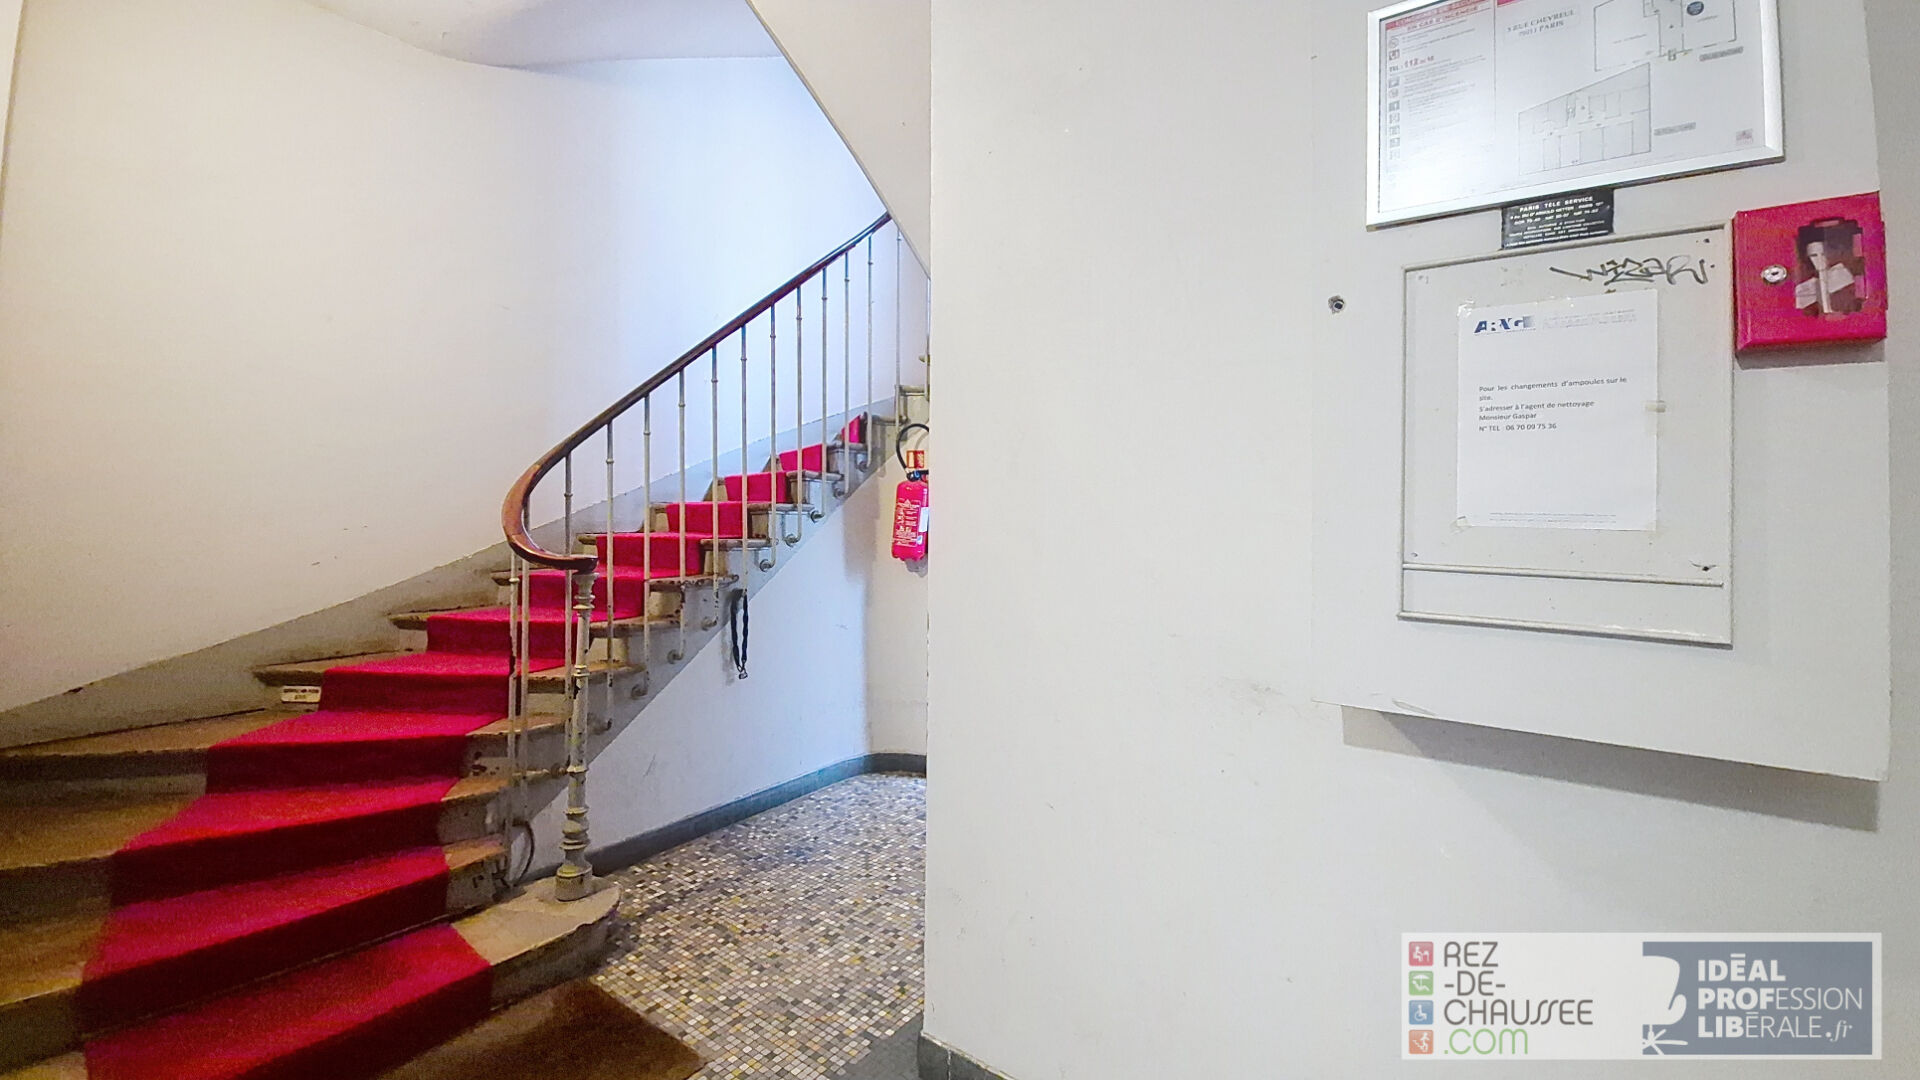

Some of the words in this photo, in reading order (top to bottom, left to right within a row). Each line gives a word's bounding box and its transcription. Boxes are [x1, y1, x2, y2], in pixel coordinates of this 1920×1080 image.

[1539, 20, 1564, 32] PARIS
[1519, 204, 1540, 212] PARIS
[1564, 196, 1593, 205] SERVICE
[1510, 382, 1558, 390] changements
[1561, 378, 1604, 387] d'ampoules
[1520, 403, 1545, 411] l'agent
[1557, 401, 1595, 409] nettoyage
